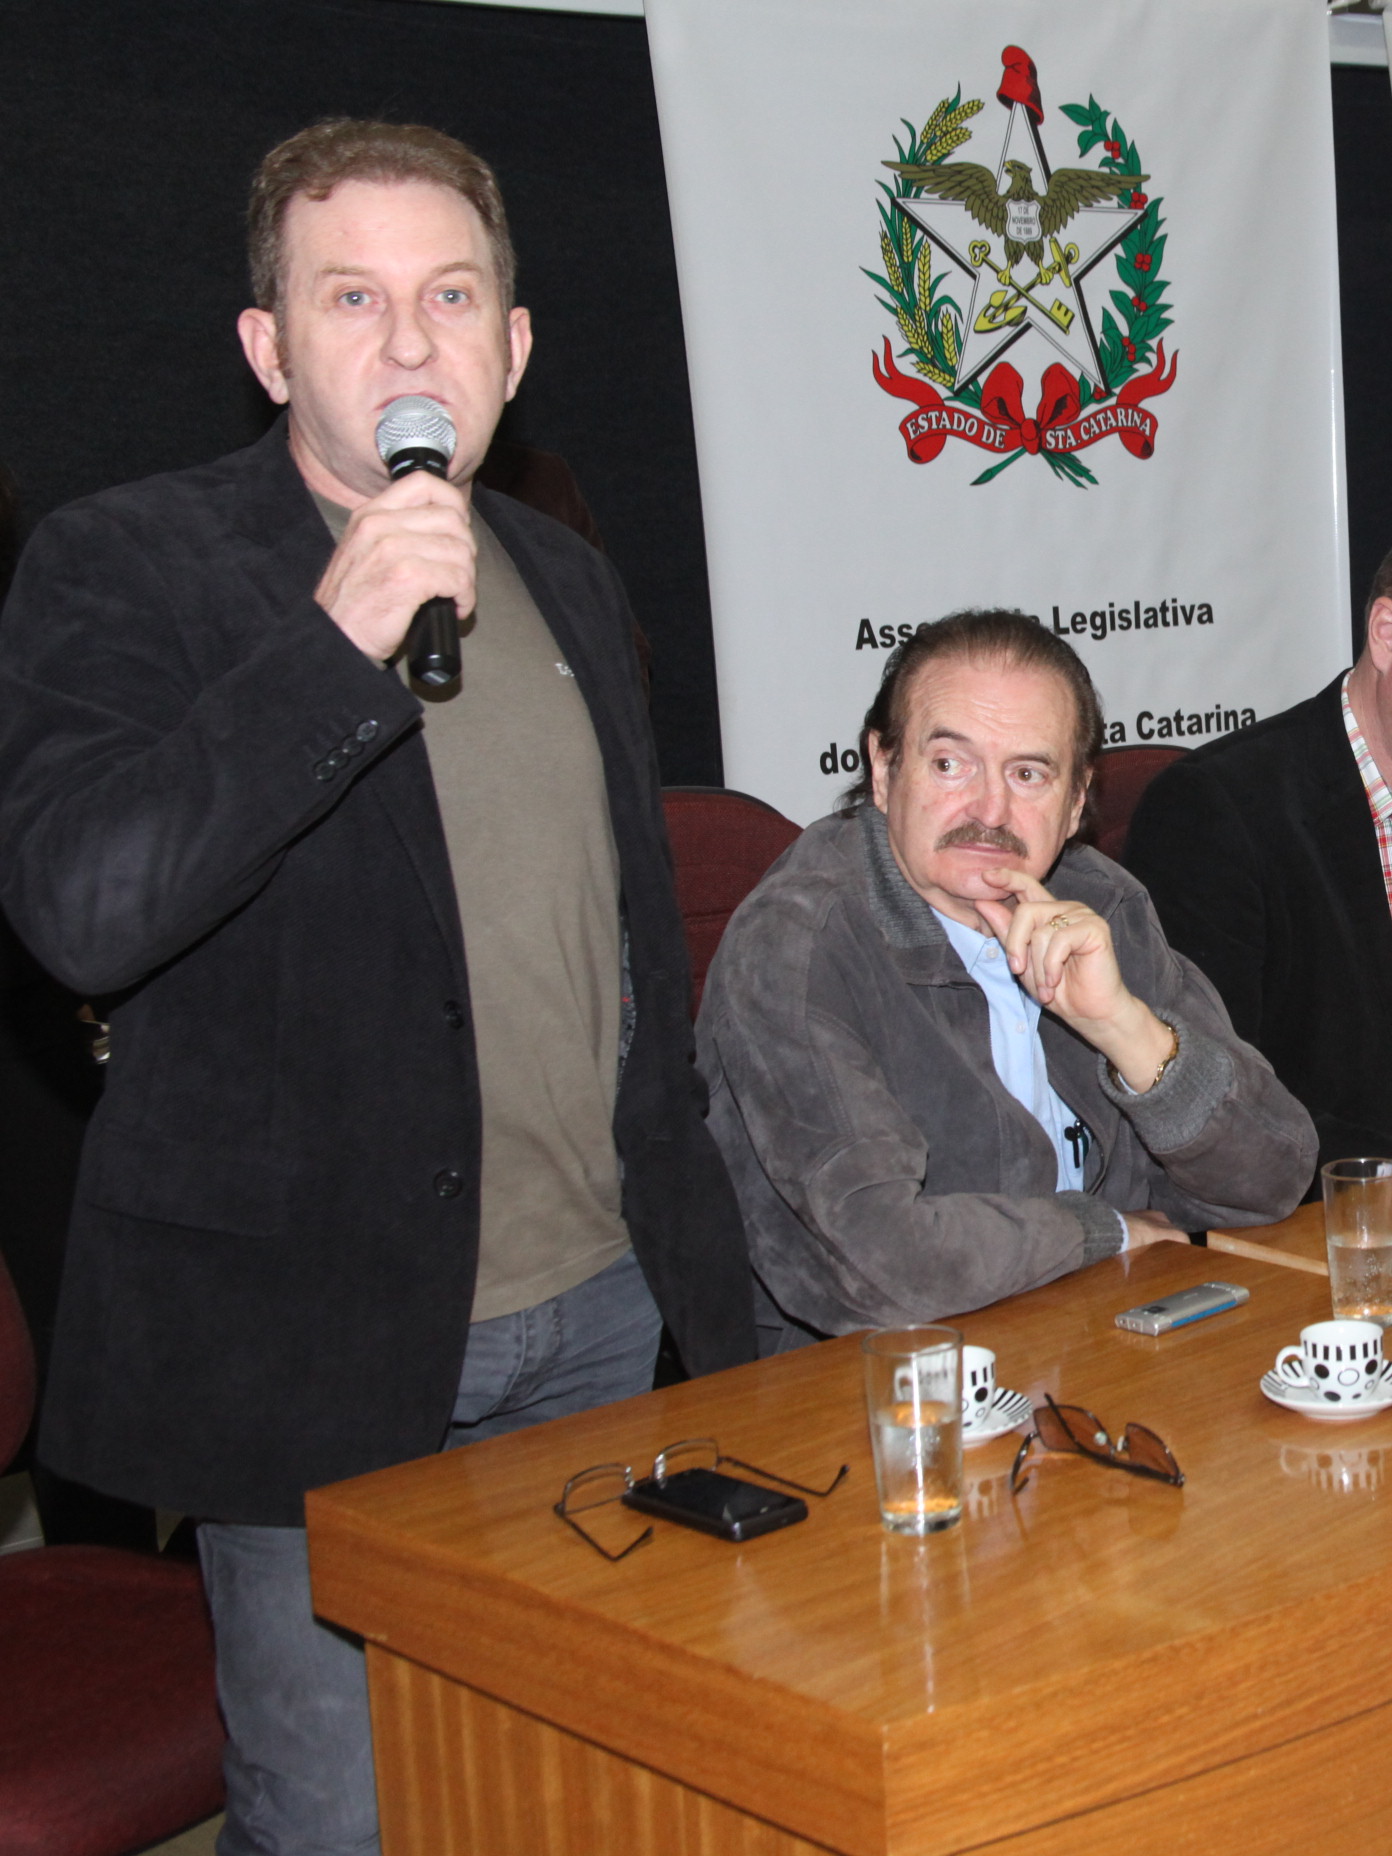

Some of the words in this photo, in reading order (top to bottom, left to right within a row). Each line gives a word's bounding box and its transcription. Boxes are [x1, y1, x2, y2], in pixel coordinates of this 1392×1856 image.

[906, 410, 978, 440] ESTADO
[981, 424, 1006, 449] DE
[1052, 597, 1214, 640] Legislativa
[820, 742, 860, 775] do
[1136, 704, 1257, 740] Catarina
